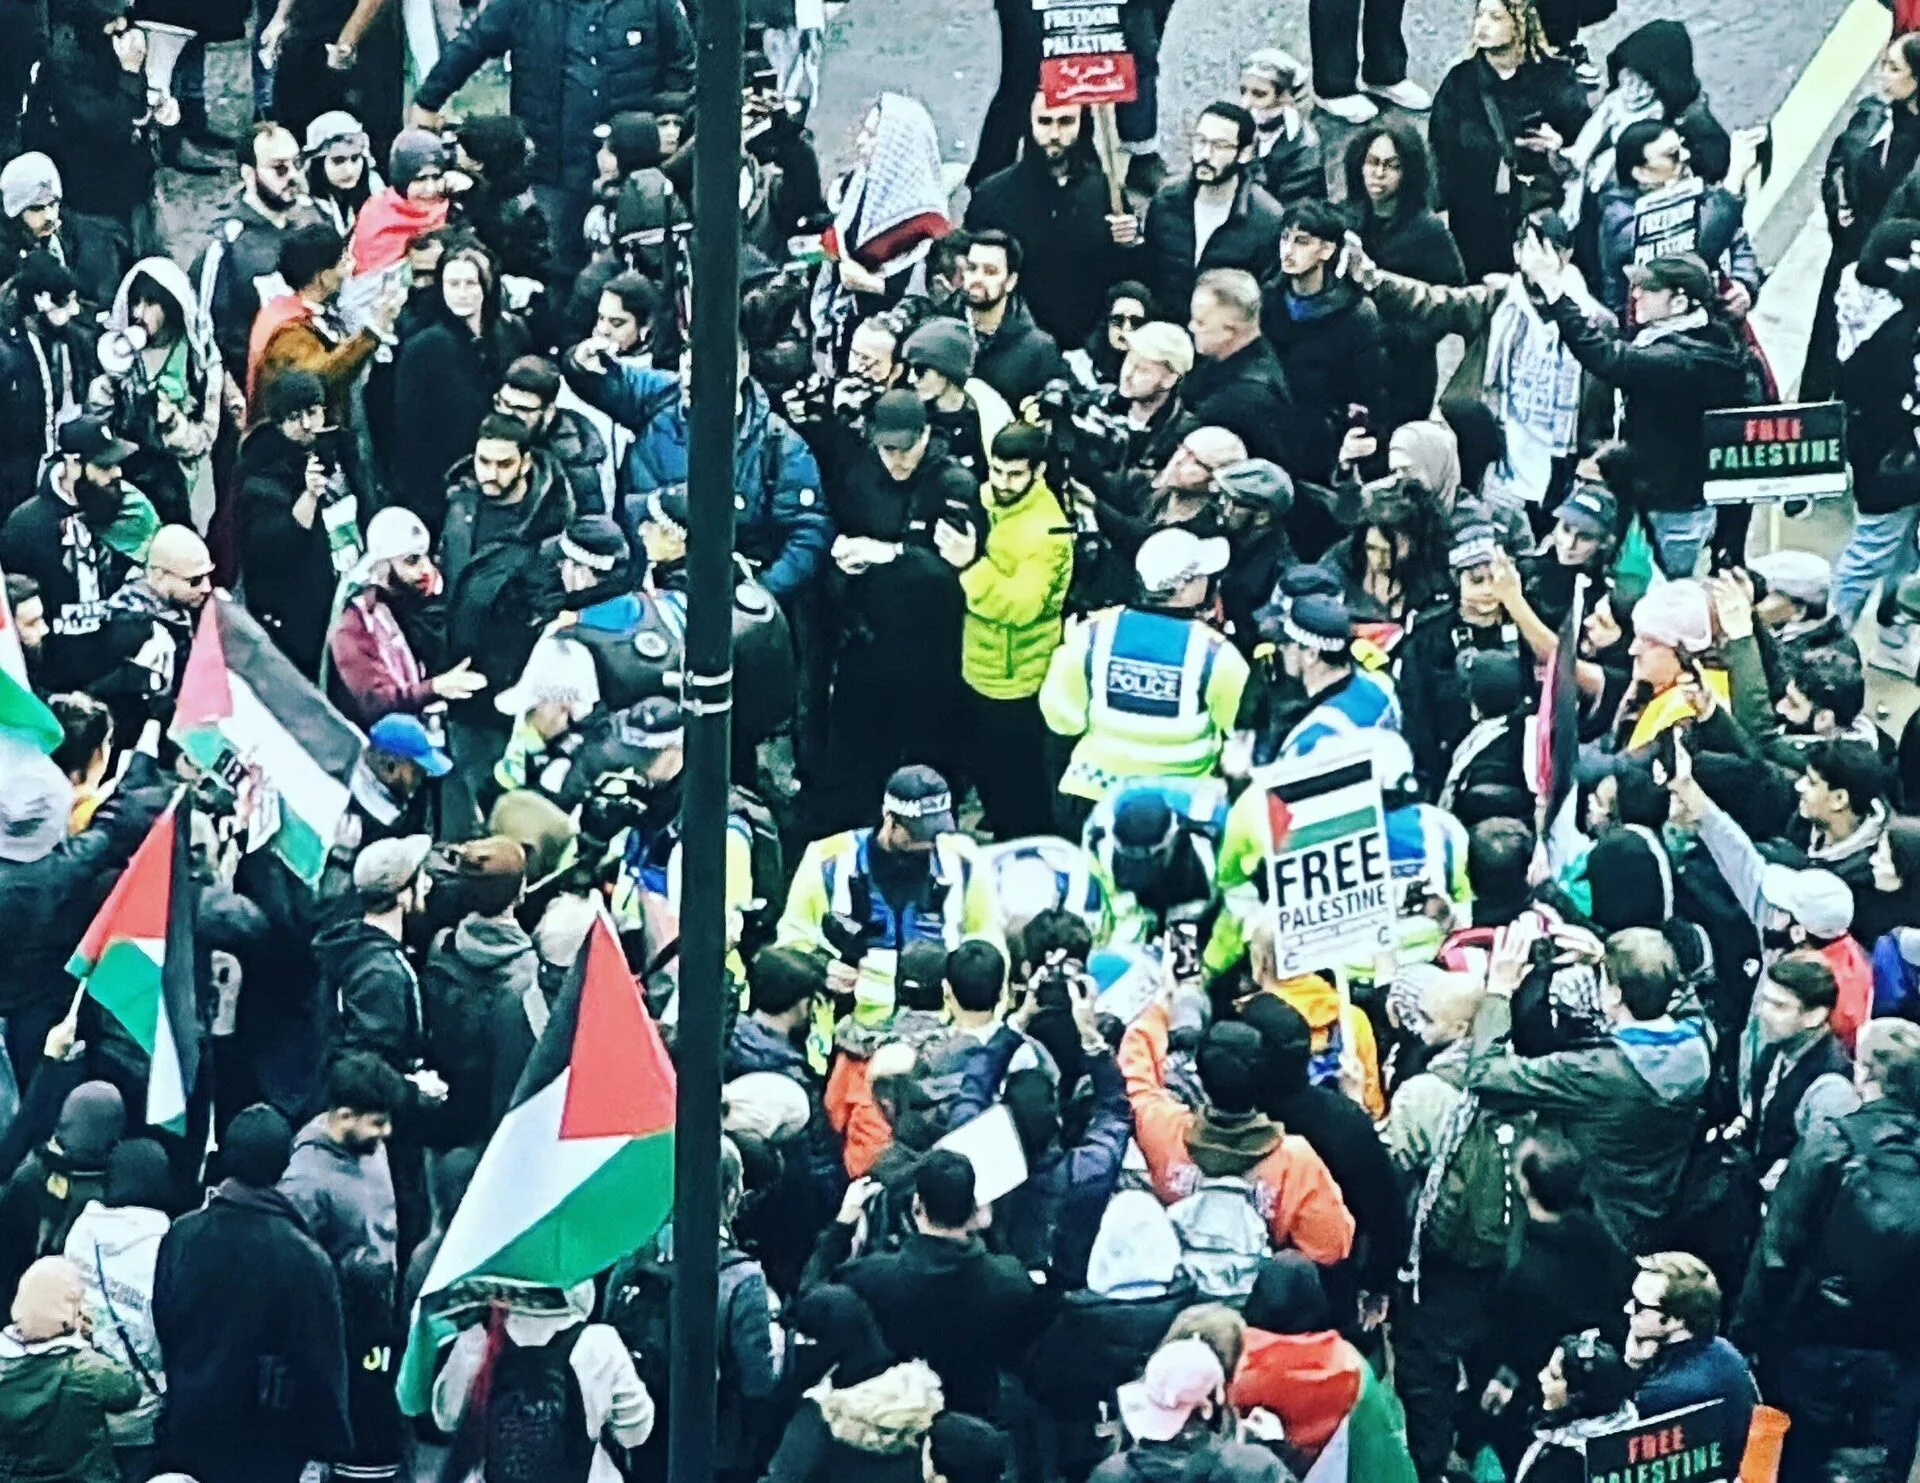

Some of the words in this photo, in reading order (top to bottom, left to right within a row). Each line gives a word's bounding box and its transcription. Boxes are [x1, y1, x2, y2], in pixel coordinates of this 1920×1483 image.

[1042, 32, 1127, 57] PALESTINE
[1708, 438, 1840, 470] PALESTINE
[1110, 671, 1180, 698] POLICE
[1275, 832, 1385, 908] FREE
[1279, 883, 1387, 932] PALESTINE
[1628, 1424, 1685, 1464] FREE
